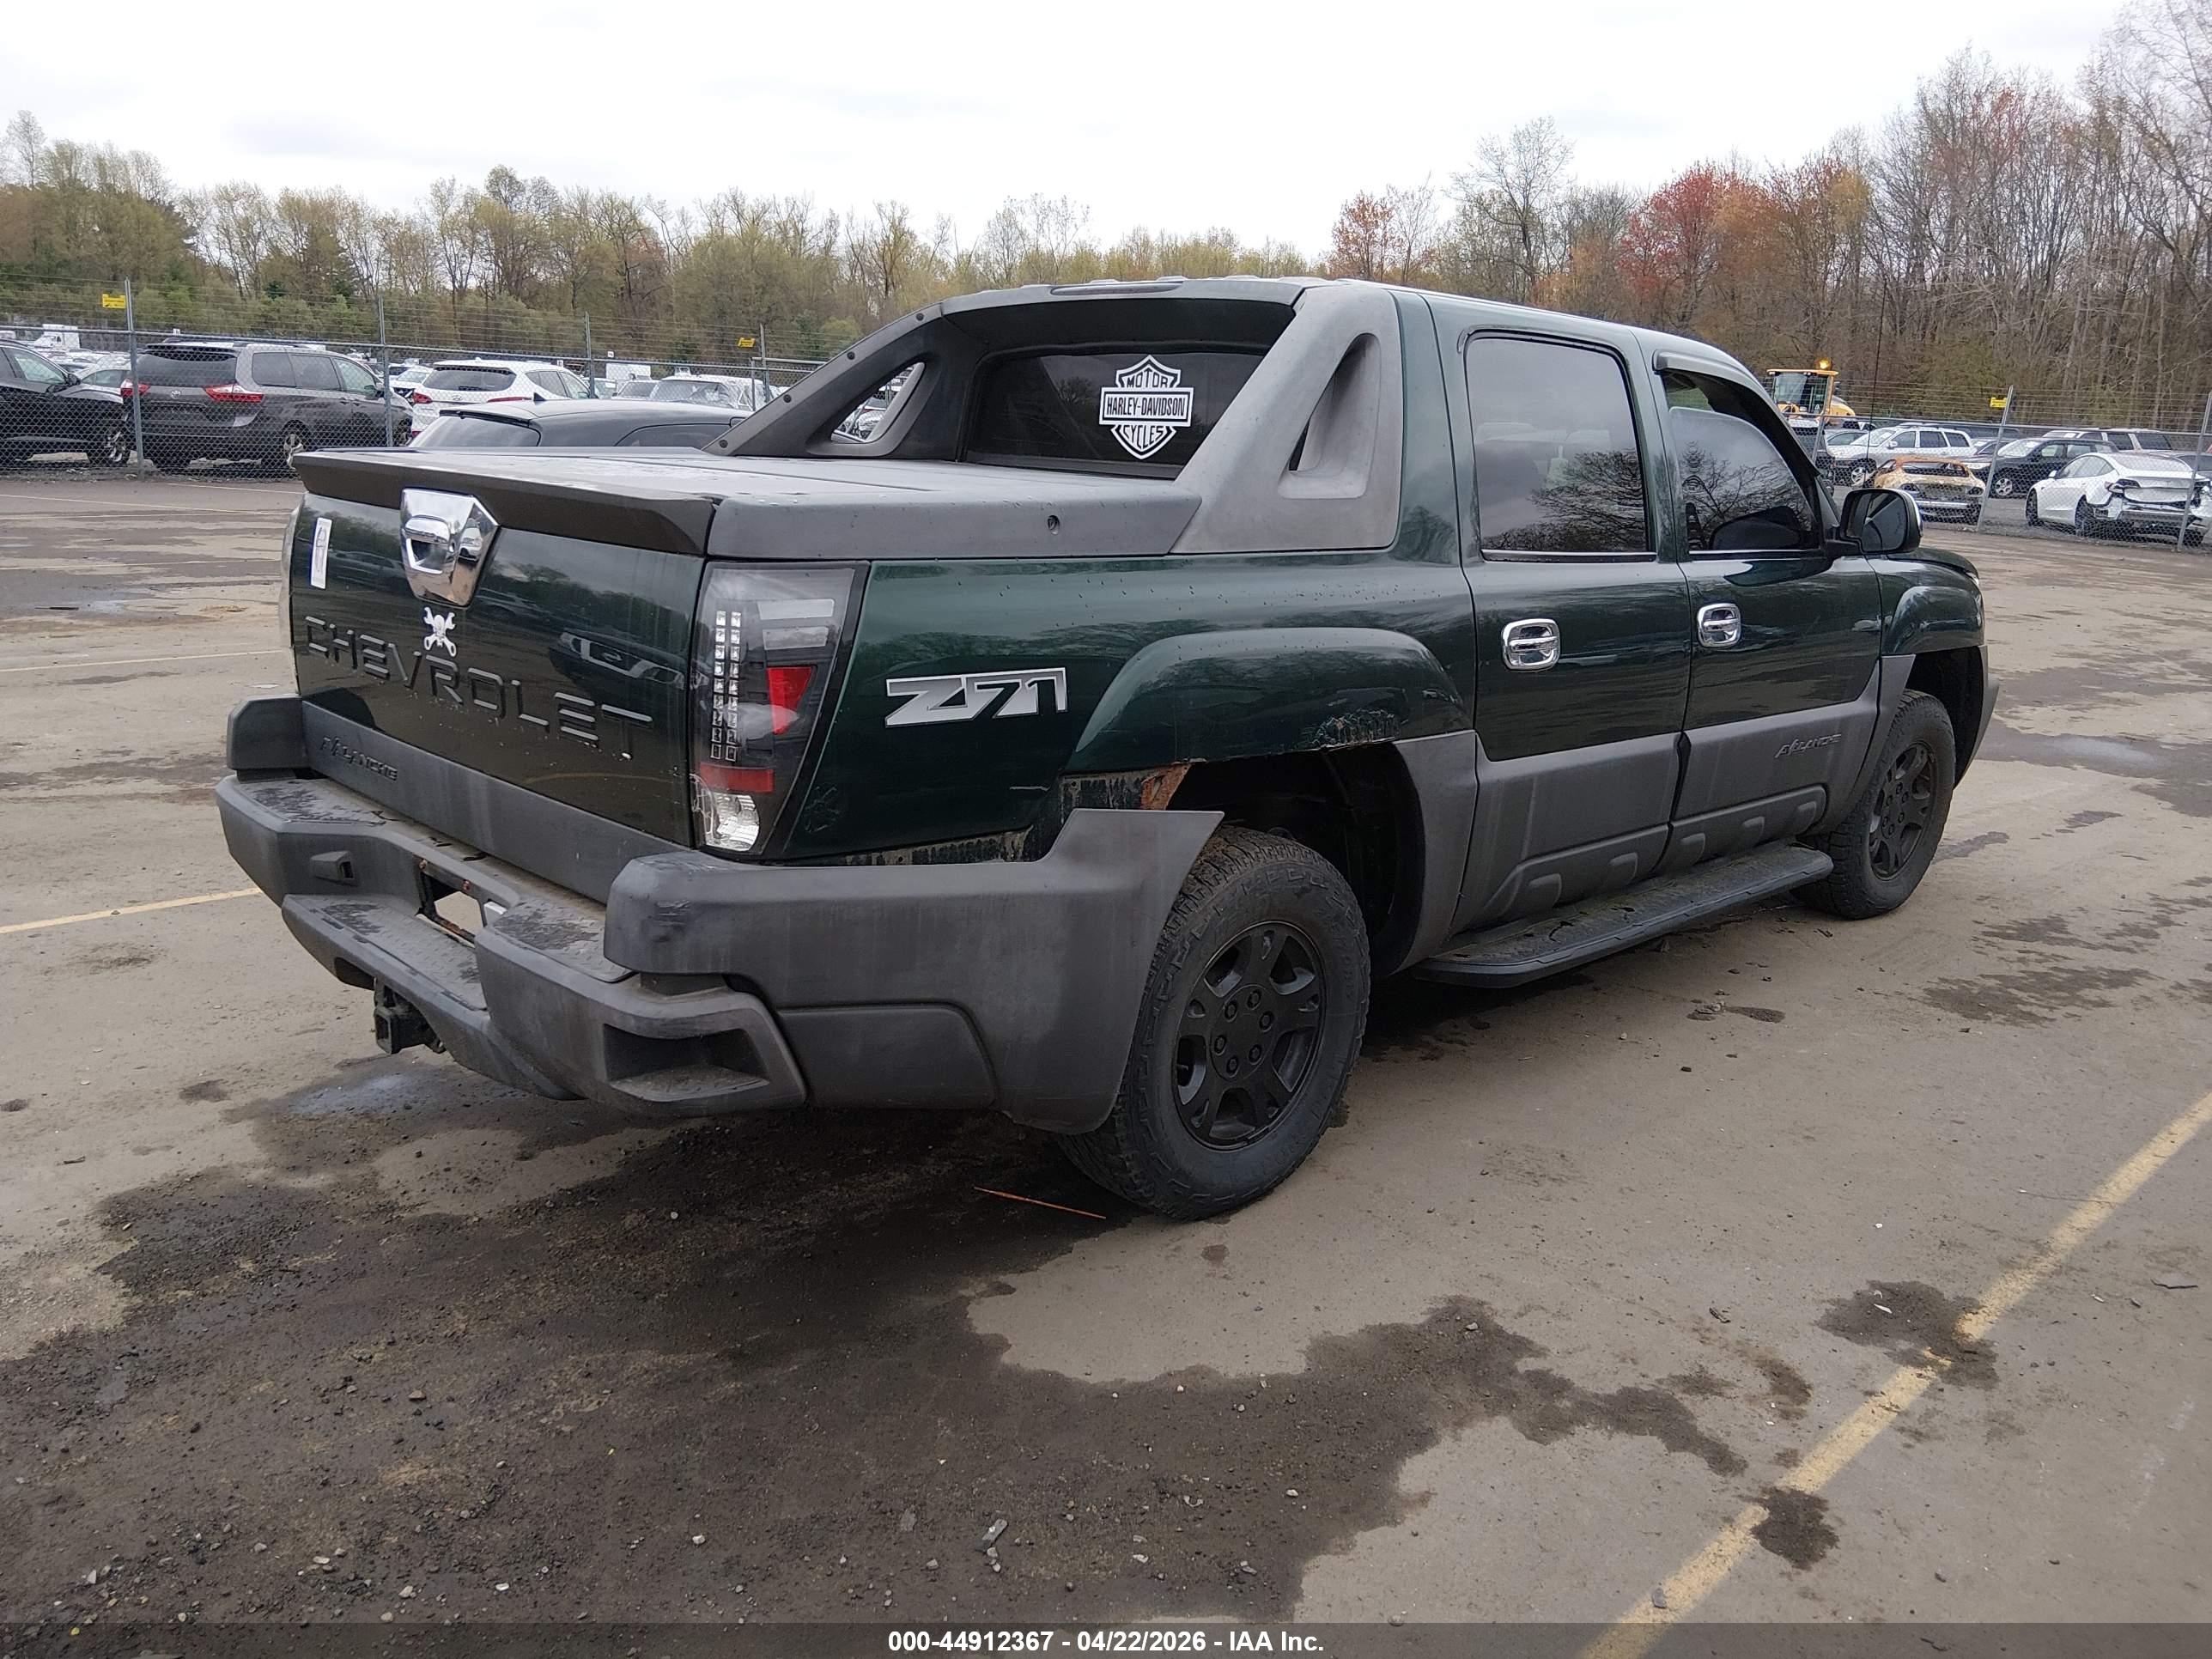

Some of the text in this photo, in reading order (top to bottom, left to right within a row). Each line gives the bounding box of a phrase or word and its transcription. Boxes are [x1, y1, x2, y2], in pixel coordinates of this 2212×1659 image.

[1127, 367, 1169, 388] MOTOR
[1106, 396, 1185, 416] HARLEY-DAVIDSON
[1122, 424, 1164, 449] CYCLES
[305, 616, 653, 761] CHEVROLET
[885, 667, 1068, 728] Z71
